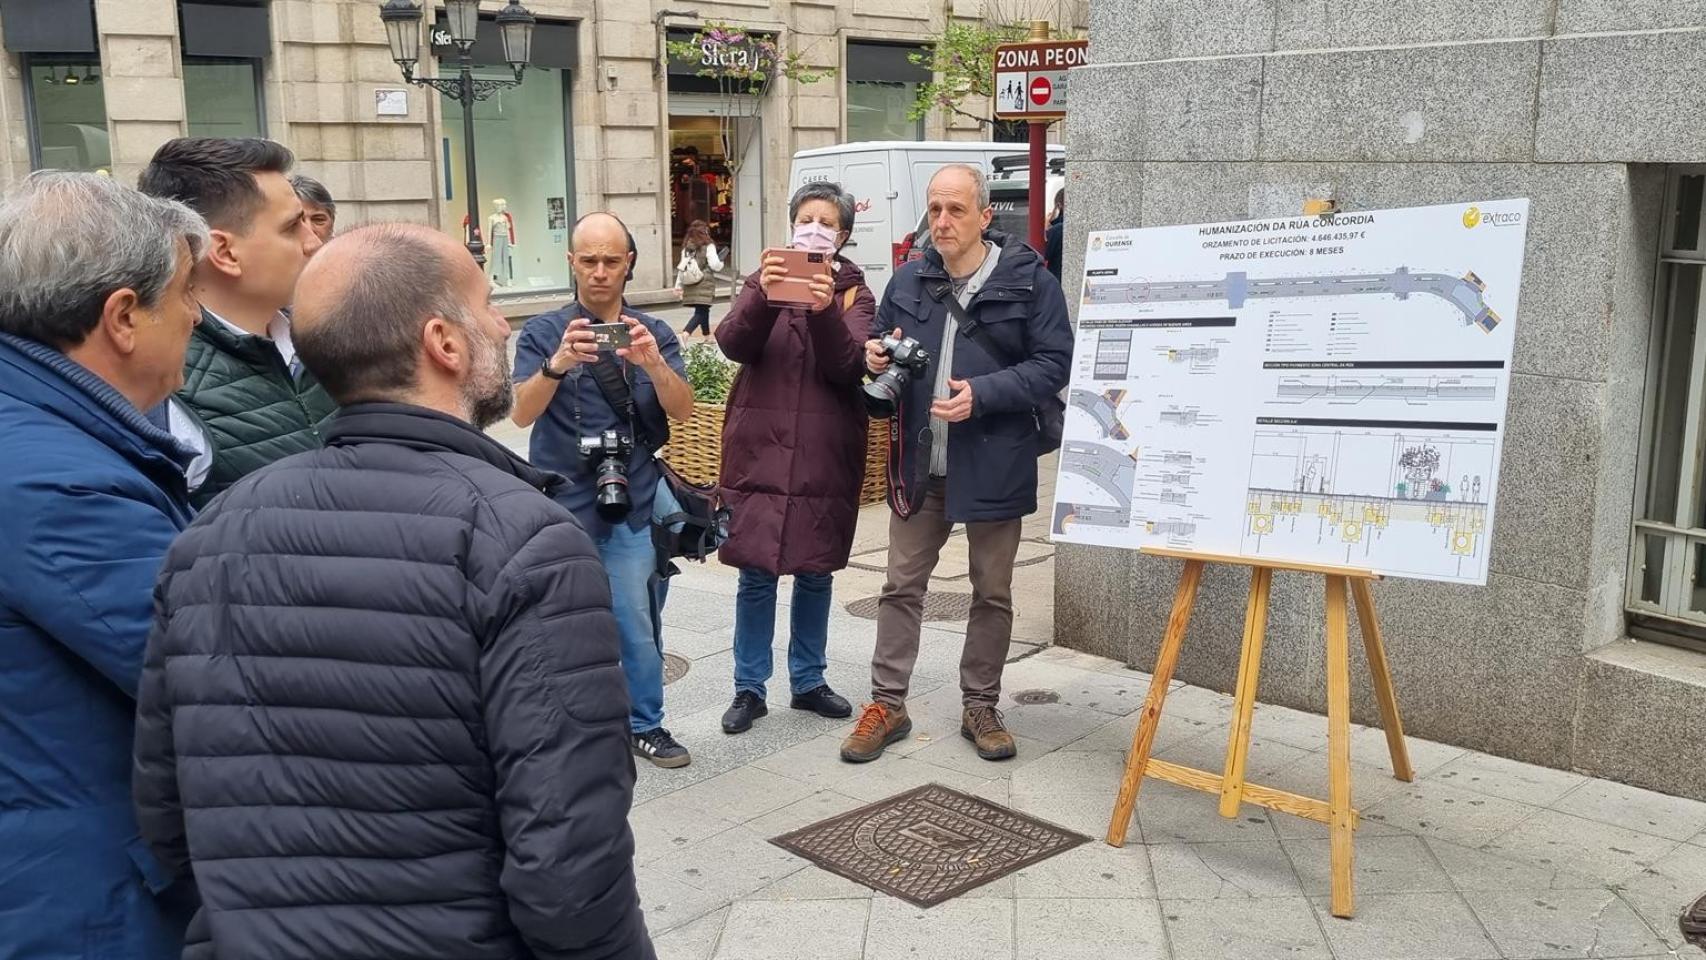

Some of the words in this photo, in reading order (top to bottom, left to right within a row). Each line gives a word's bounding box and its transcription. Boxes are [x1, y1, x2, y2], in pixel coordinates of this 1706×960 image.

[997, 49, 1040, 68] ZONA
[1045, 47, 1089, 66] PEON
[1272, 221, 1286, 231] DA
[1312, 214, 1375, 228] CONCORDIA
[1482, 212, 1521, 225] extraco
[1105, 240, 1133, 248] OURENSE
[1202, 239, 1250, 249] ORZAMENTO
[1250, 238, 1261, 246] DE
[1312, 231, 1359, 242] 4.646.435,97
[1360, 230, 1366, 239] €
[1219, 251, 1245, 261] PRAZO
[1247, 251, 1258, 259] DE
[1309, 248, 1314, 256] 8
[1316, 246, 1344, 255] MESES
